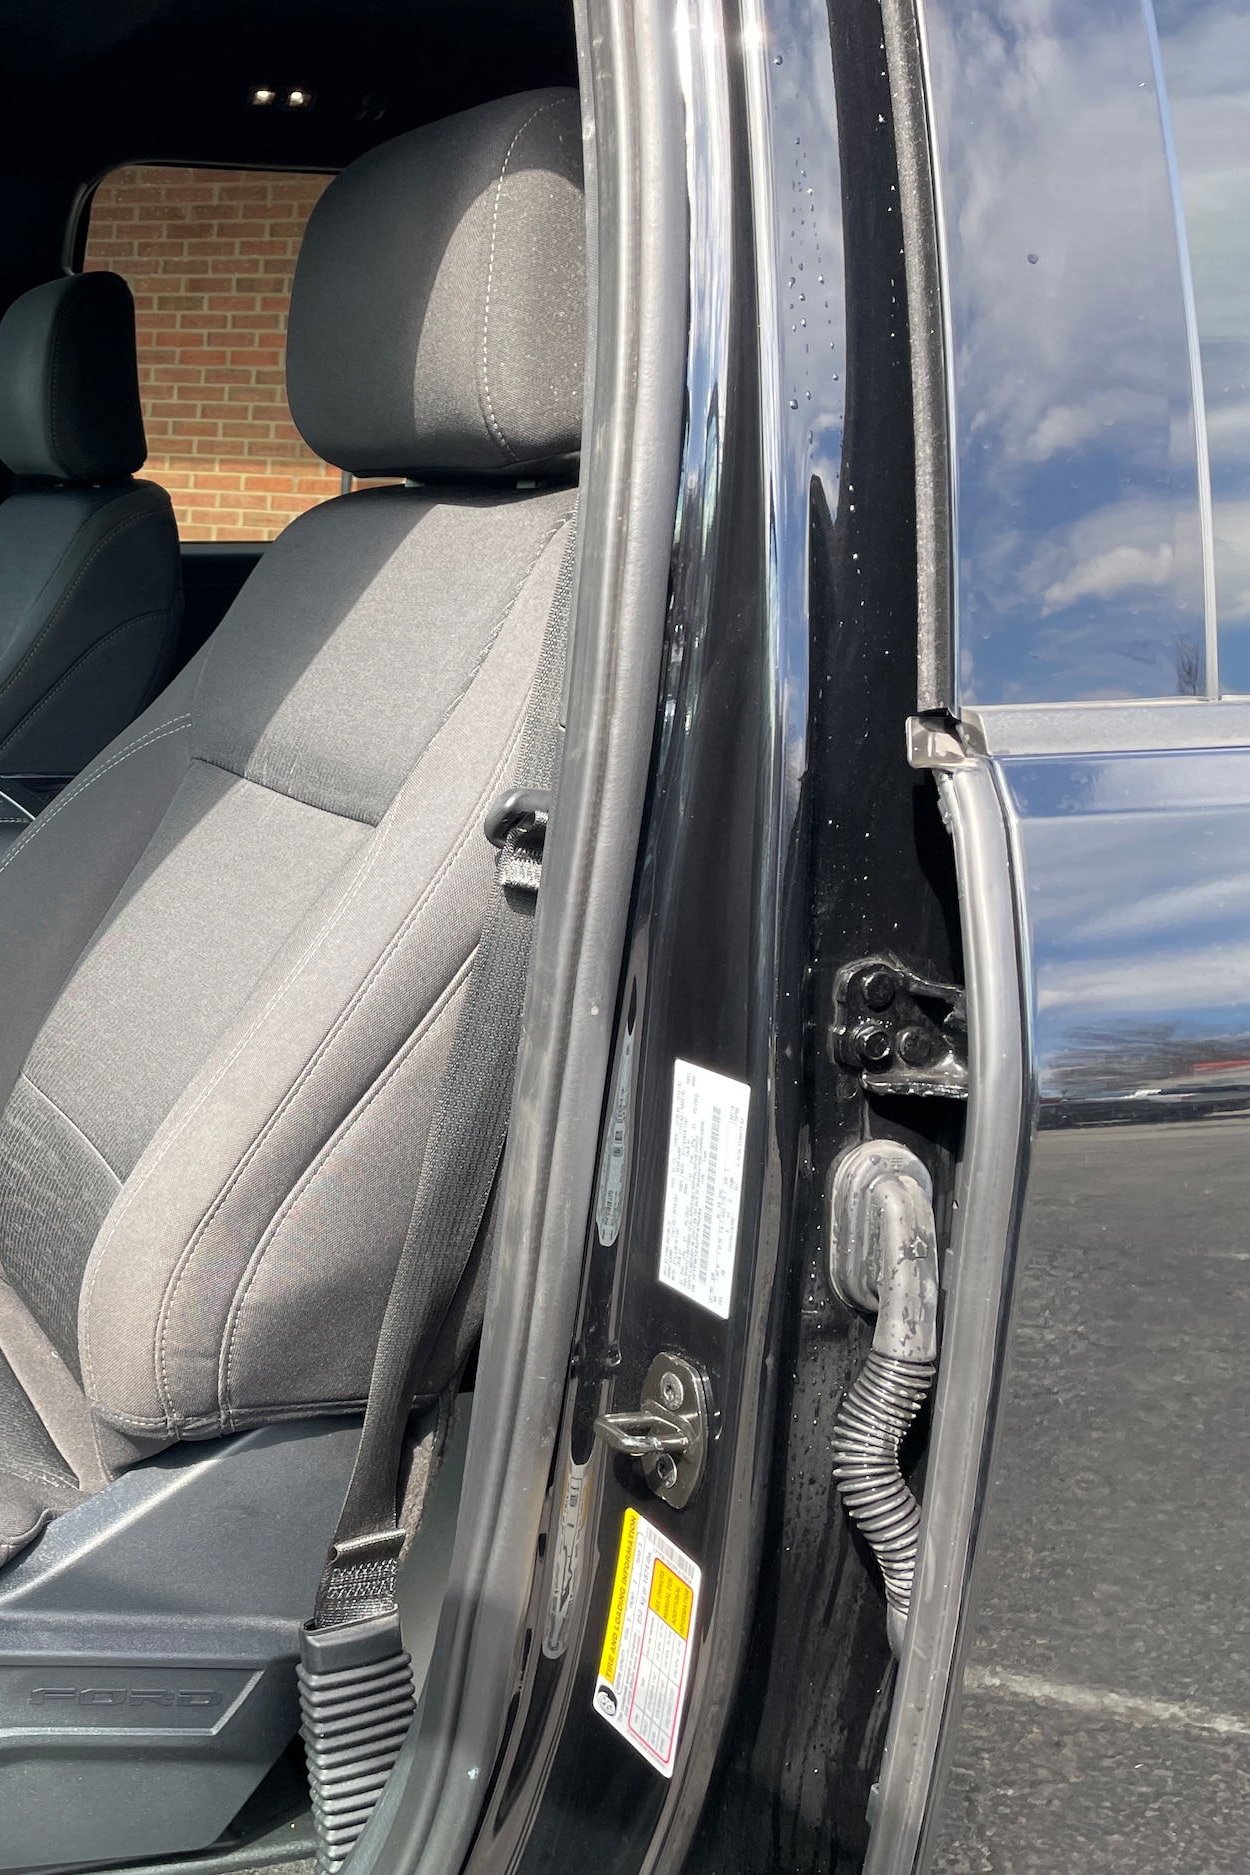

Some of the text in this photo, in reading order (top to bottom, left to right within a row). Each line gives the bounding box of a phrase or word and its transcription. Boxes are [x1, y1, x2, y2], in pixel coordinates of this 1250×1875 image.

[605, 1515, 637, 1678] TIRE AND LOADING INFORMATION
[657, 1569, 665, 1598] OWNERS
[663, 1591, 671, 1619] MANUAL
[671, 1584, 681, 1625] ADDITIONAL
[679, 1587, 690, 1634] INFORMATION
[28, 1687, 223, 1707] FORD
